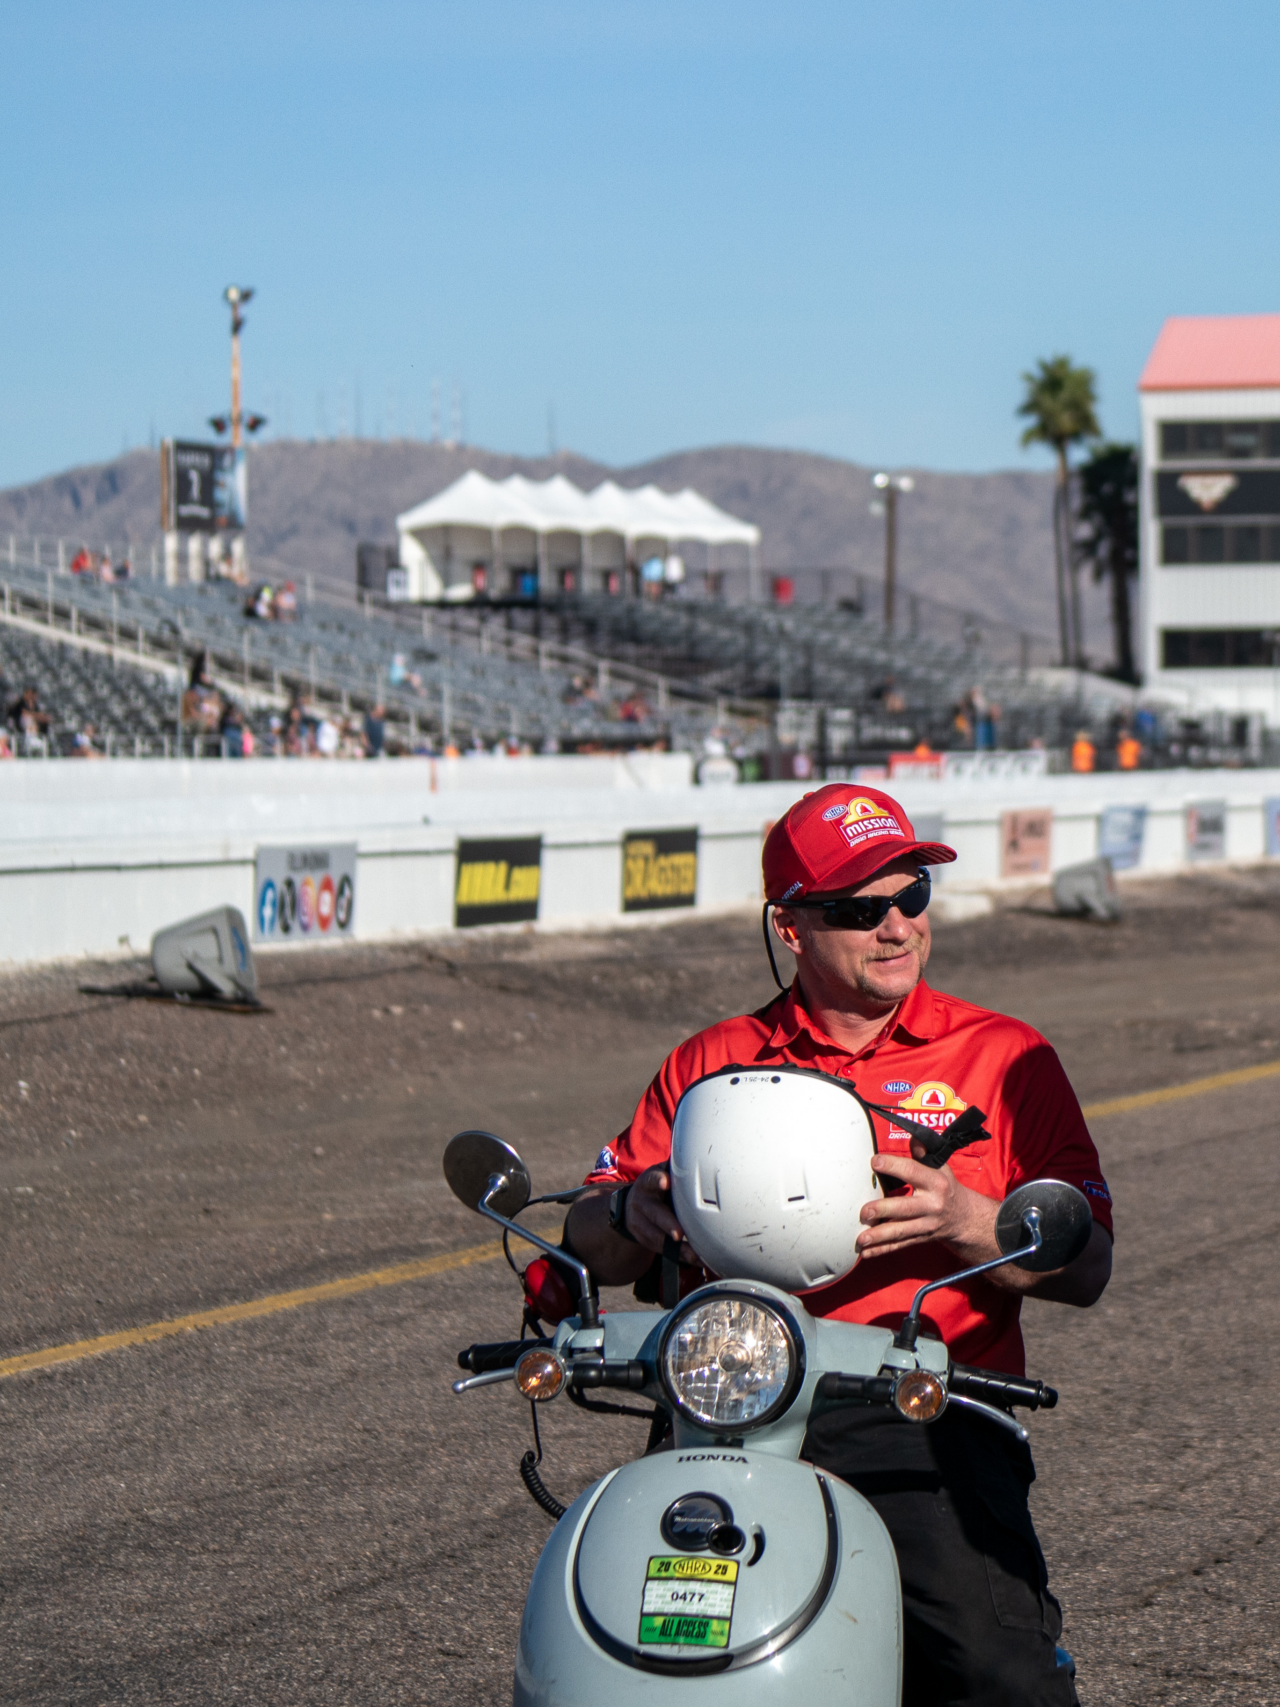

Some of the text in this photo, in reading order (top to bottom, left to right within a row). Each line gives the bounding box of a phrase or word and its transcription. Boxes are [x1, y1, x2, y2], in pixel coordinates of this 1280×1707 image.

[846, 817, 898, 838] MISSION
[885, 1082, 911, 1093] NHRA
[896, 1112, 959, 1128] MISSIO
[888, 1132, 912, 1140] DRAG
[676, 1453, 750, 1465] HONDA
[657, 1560, 729, 1576] 20 NHRA 25
[671, 1591, 705, 1603] 0477
[659, 1617, 710, 1639] ALL ACCESS
